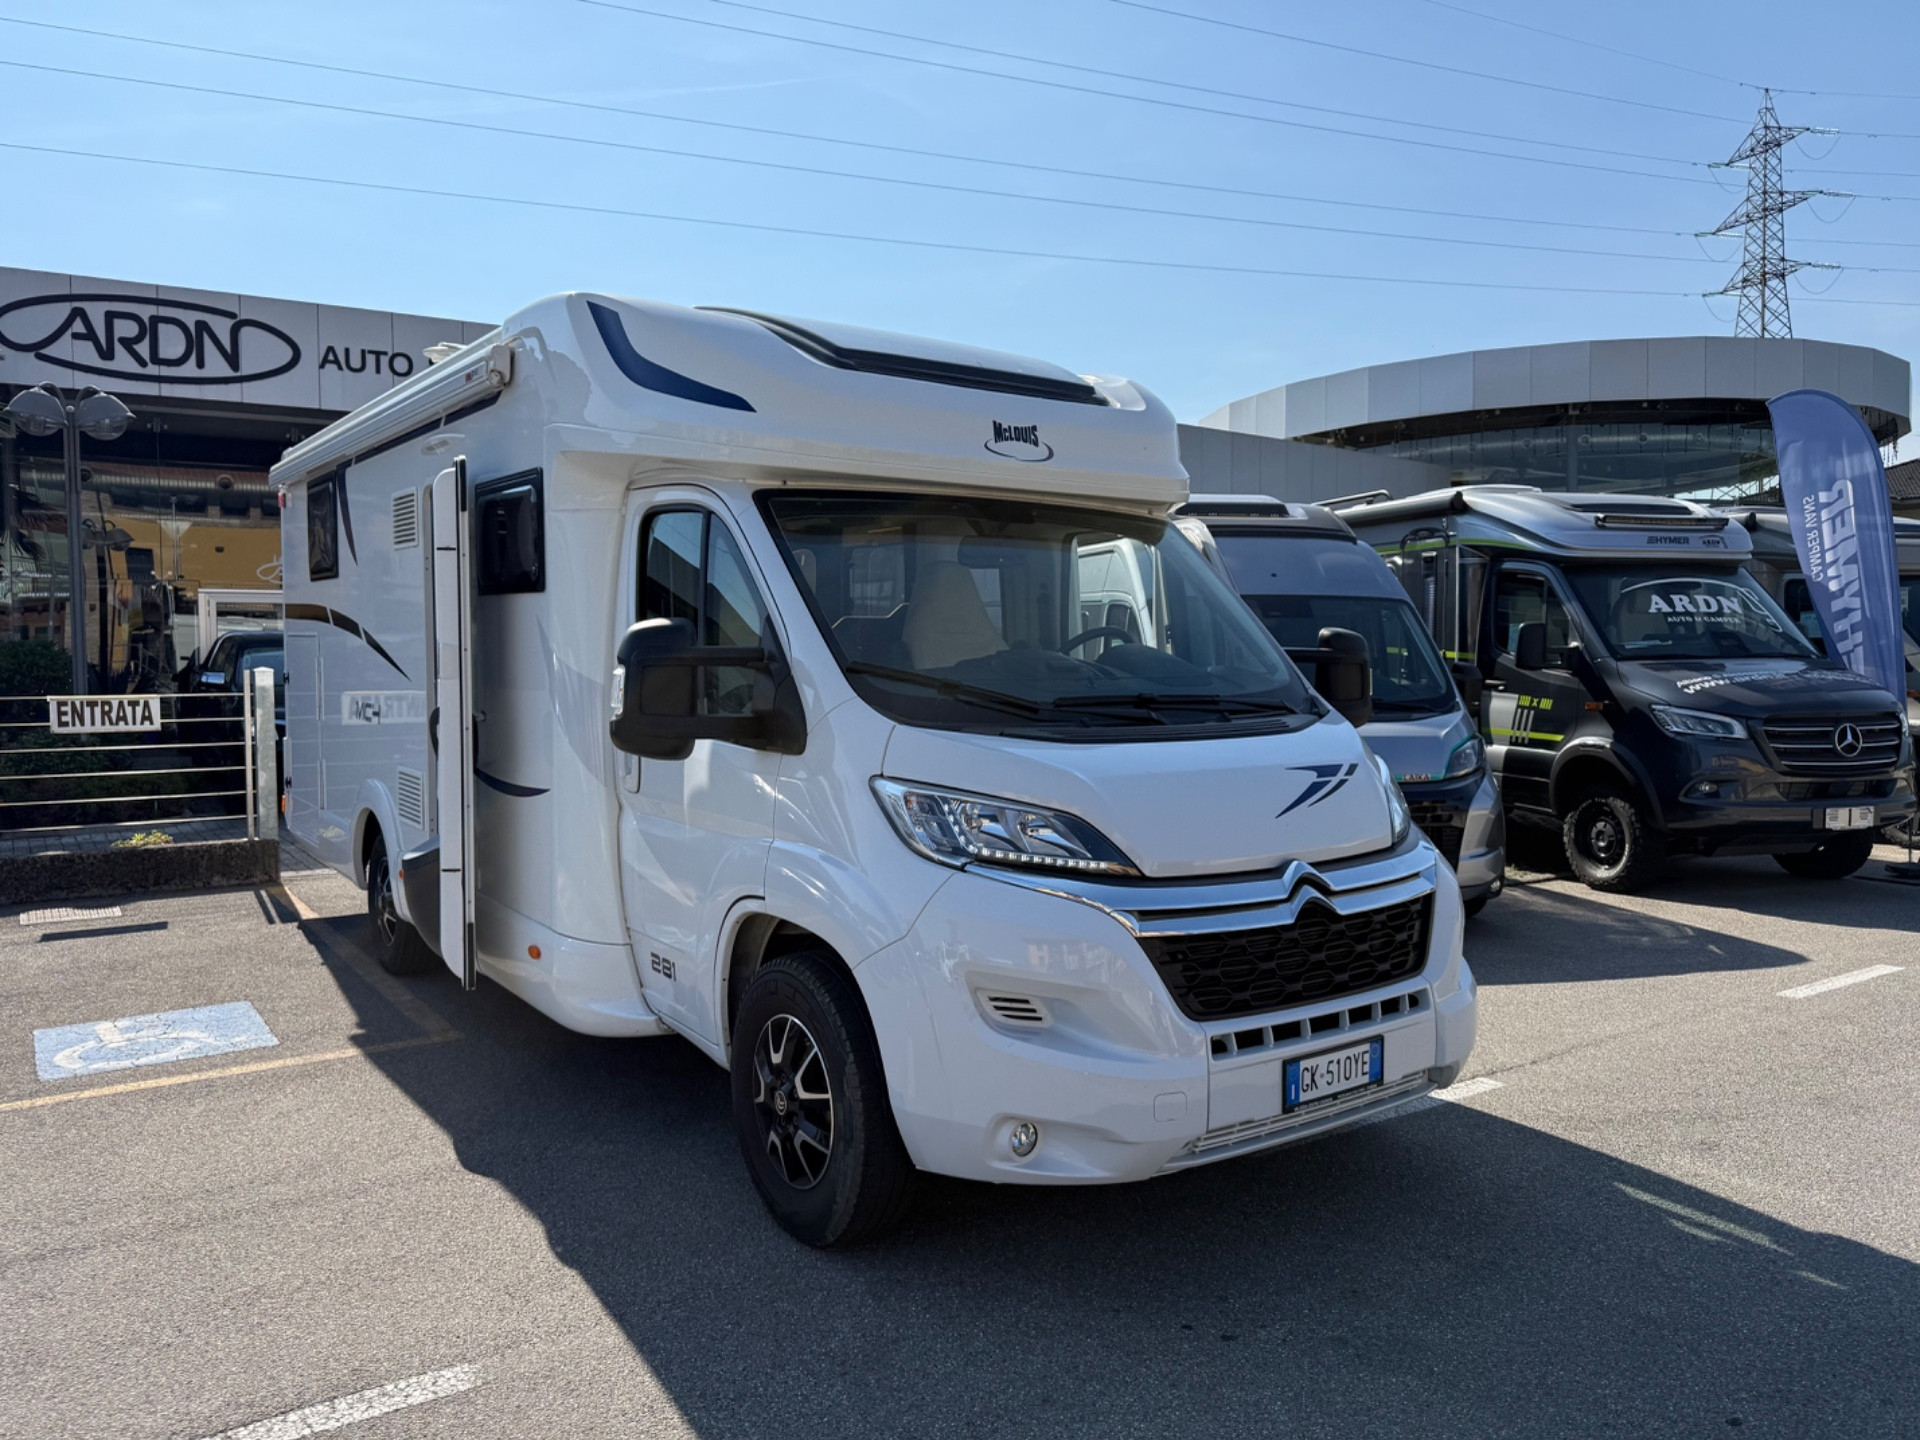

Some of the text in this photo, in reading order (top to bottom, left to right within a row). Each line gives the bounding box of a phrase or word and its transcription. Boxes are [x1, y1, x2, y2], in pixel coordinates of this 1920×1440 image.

[50, 306, 241, 373] ARDN
[318, 345, 414, 377] AUTO
[1648, 593, 1743, 614] ARDN
[56, 700, 154, 728] ENTRATA
[650, 951, 677, 982] 281
